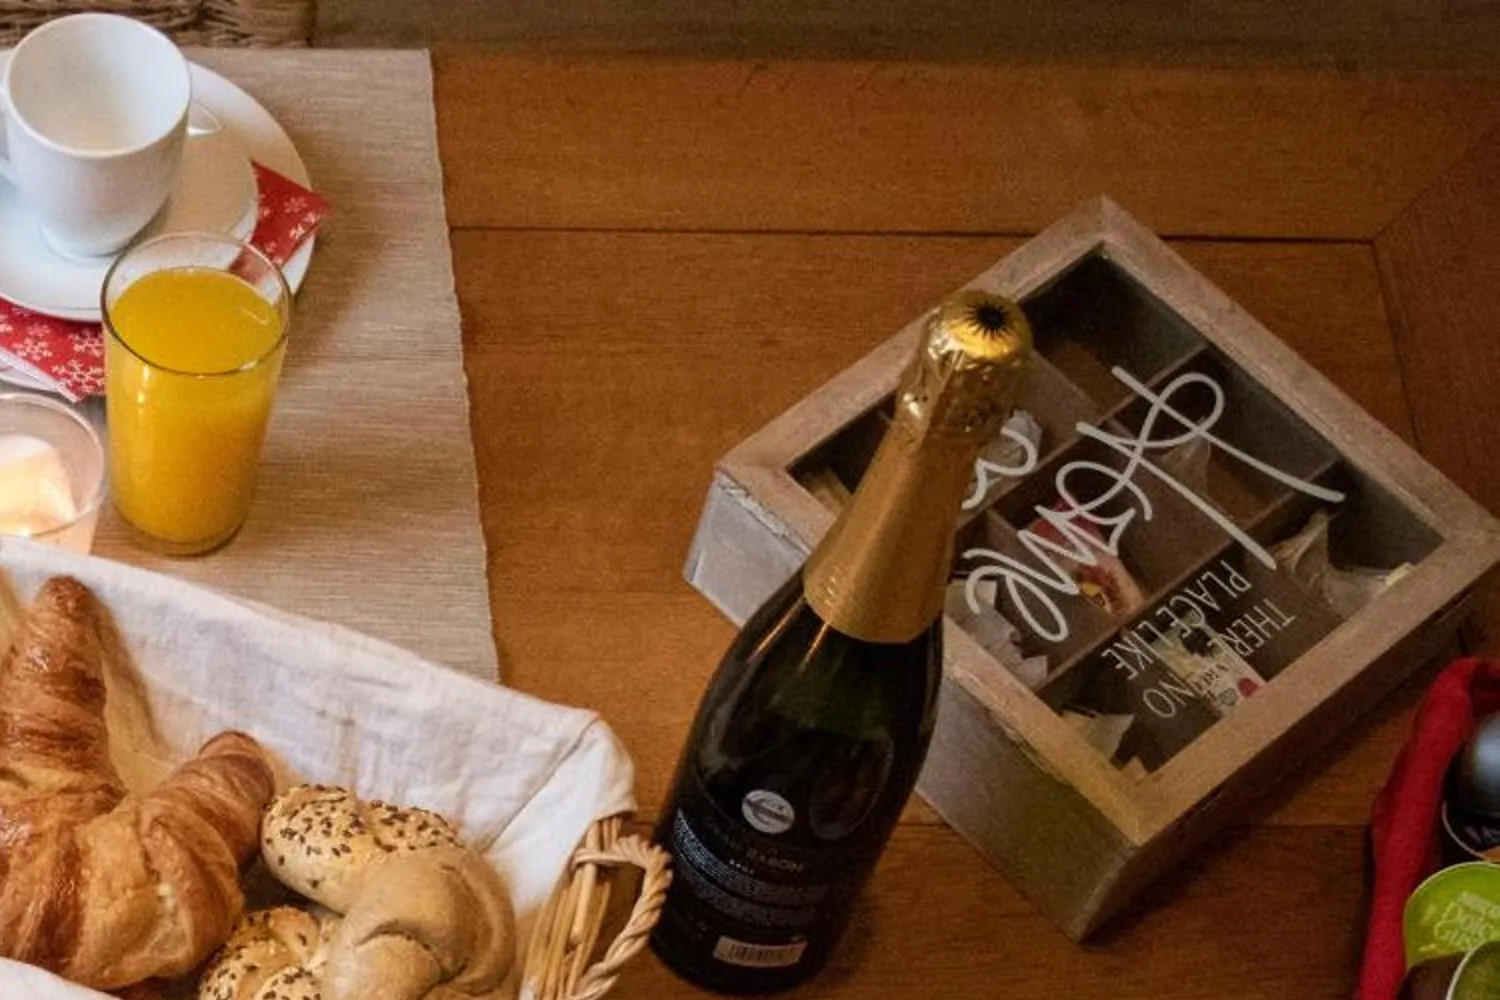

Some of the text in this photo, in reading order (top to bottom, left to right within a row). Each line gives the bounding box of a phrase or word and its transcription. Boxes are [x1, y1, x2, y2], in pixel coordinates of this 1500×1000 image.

[965, 365, 1345, 643] Home
[1100, 559, 1250, 681] PLACE LIKE
[1140, 672, 1194, 716] NO
